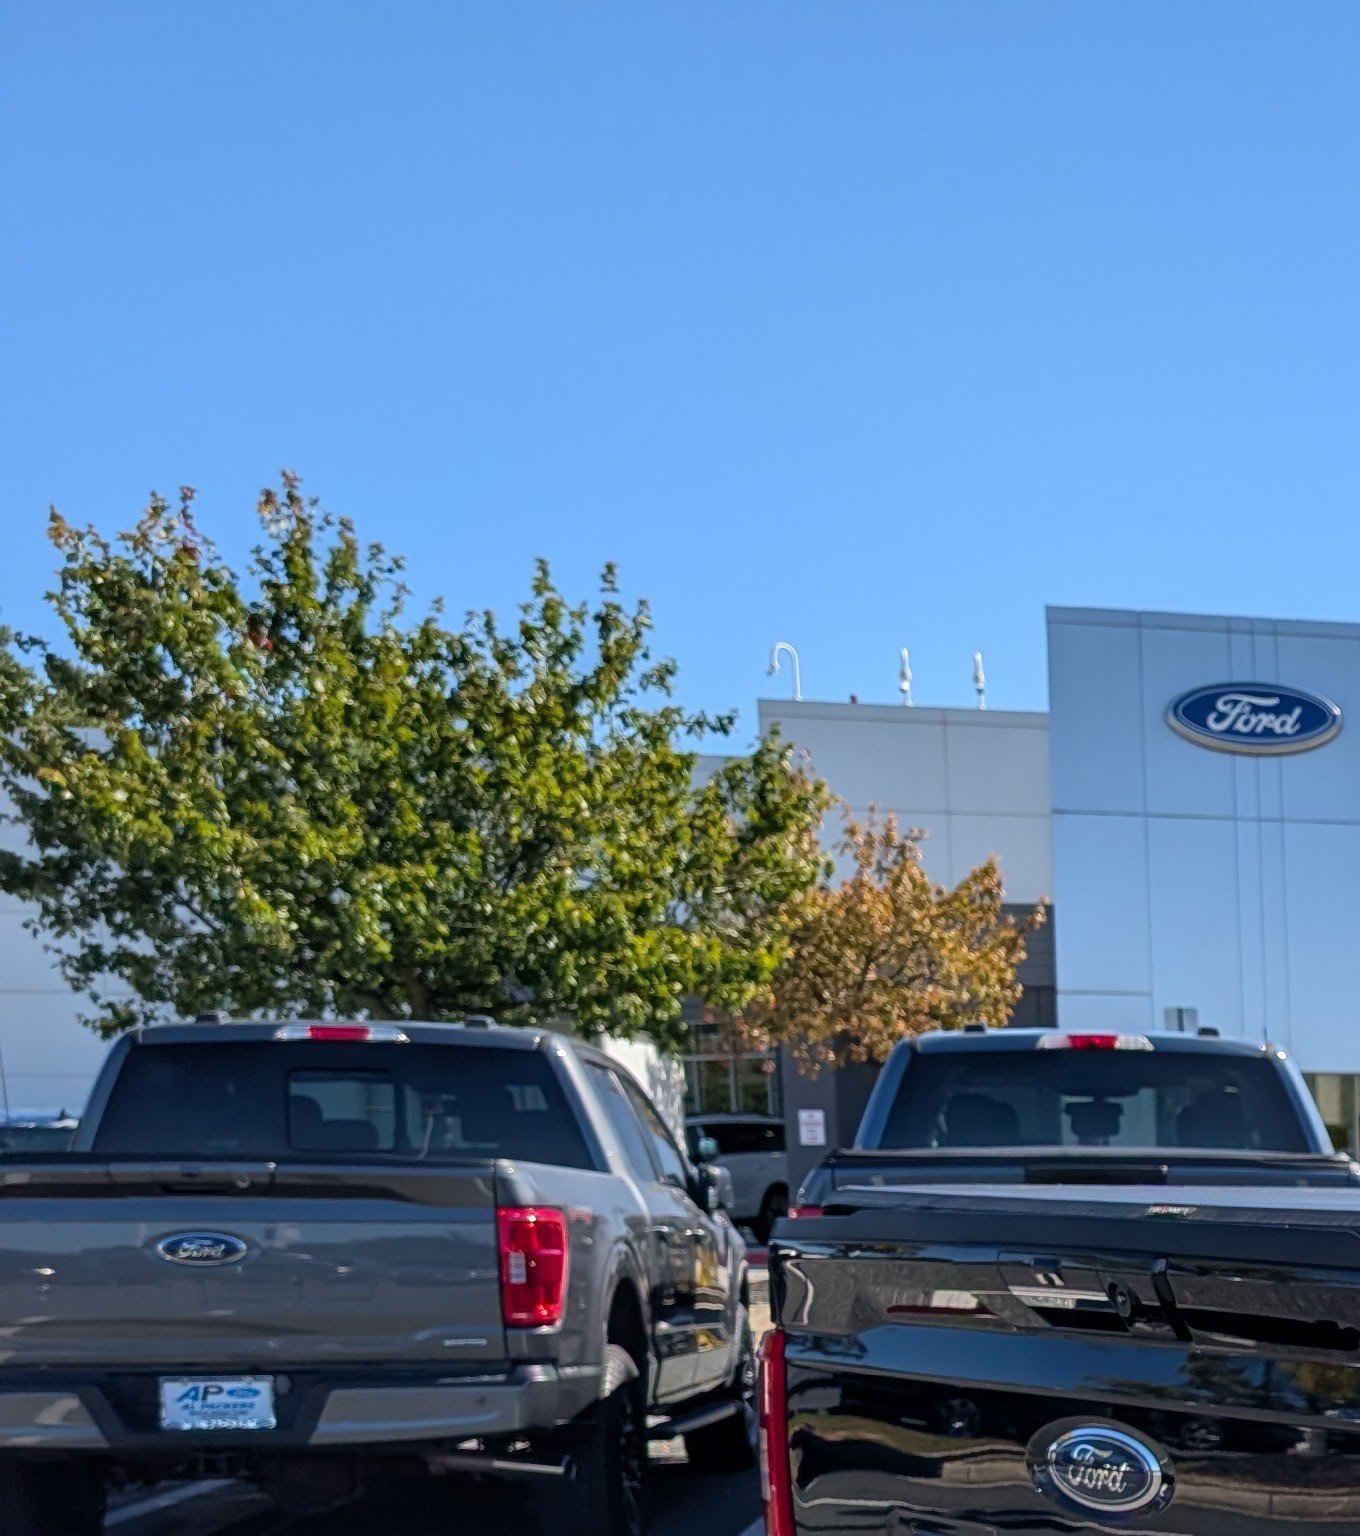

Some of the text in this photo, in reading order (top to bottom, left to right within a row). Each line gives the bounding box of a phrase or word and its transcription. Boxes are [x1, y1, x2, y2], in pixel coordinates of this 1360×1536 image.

[1205, 693, 1302, 735] Ford
[176, 1384, 224, 1402] AP
[1067, 1443, 1129, 1494] Ford
